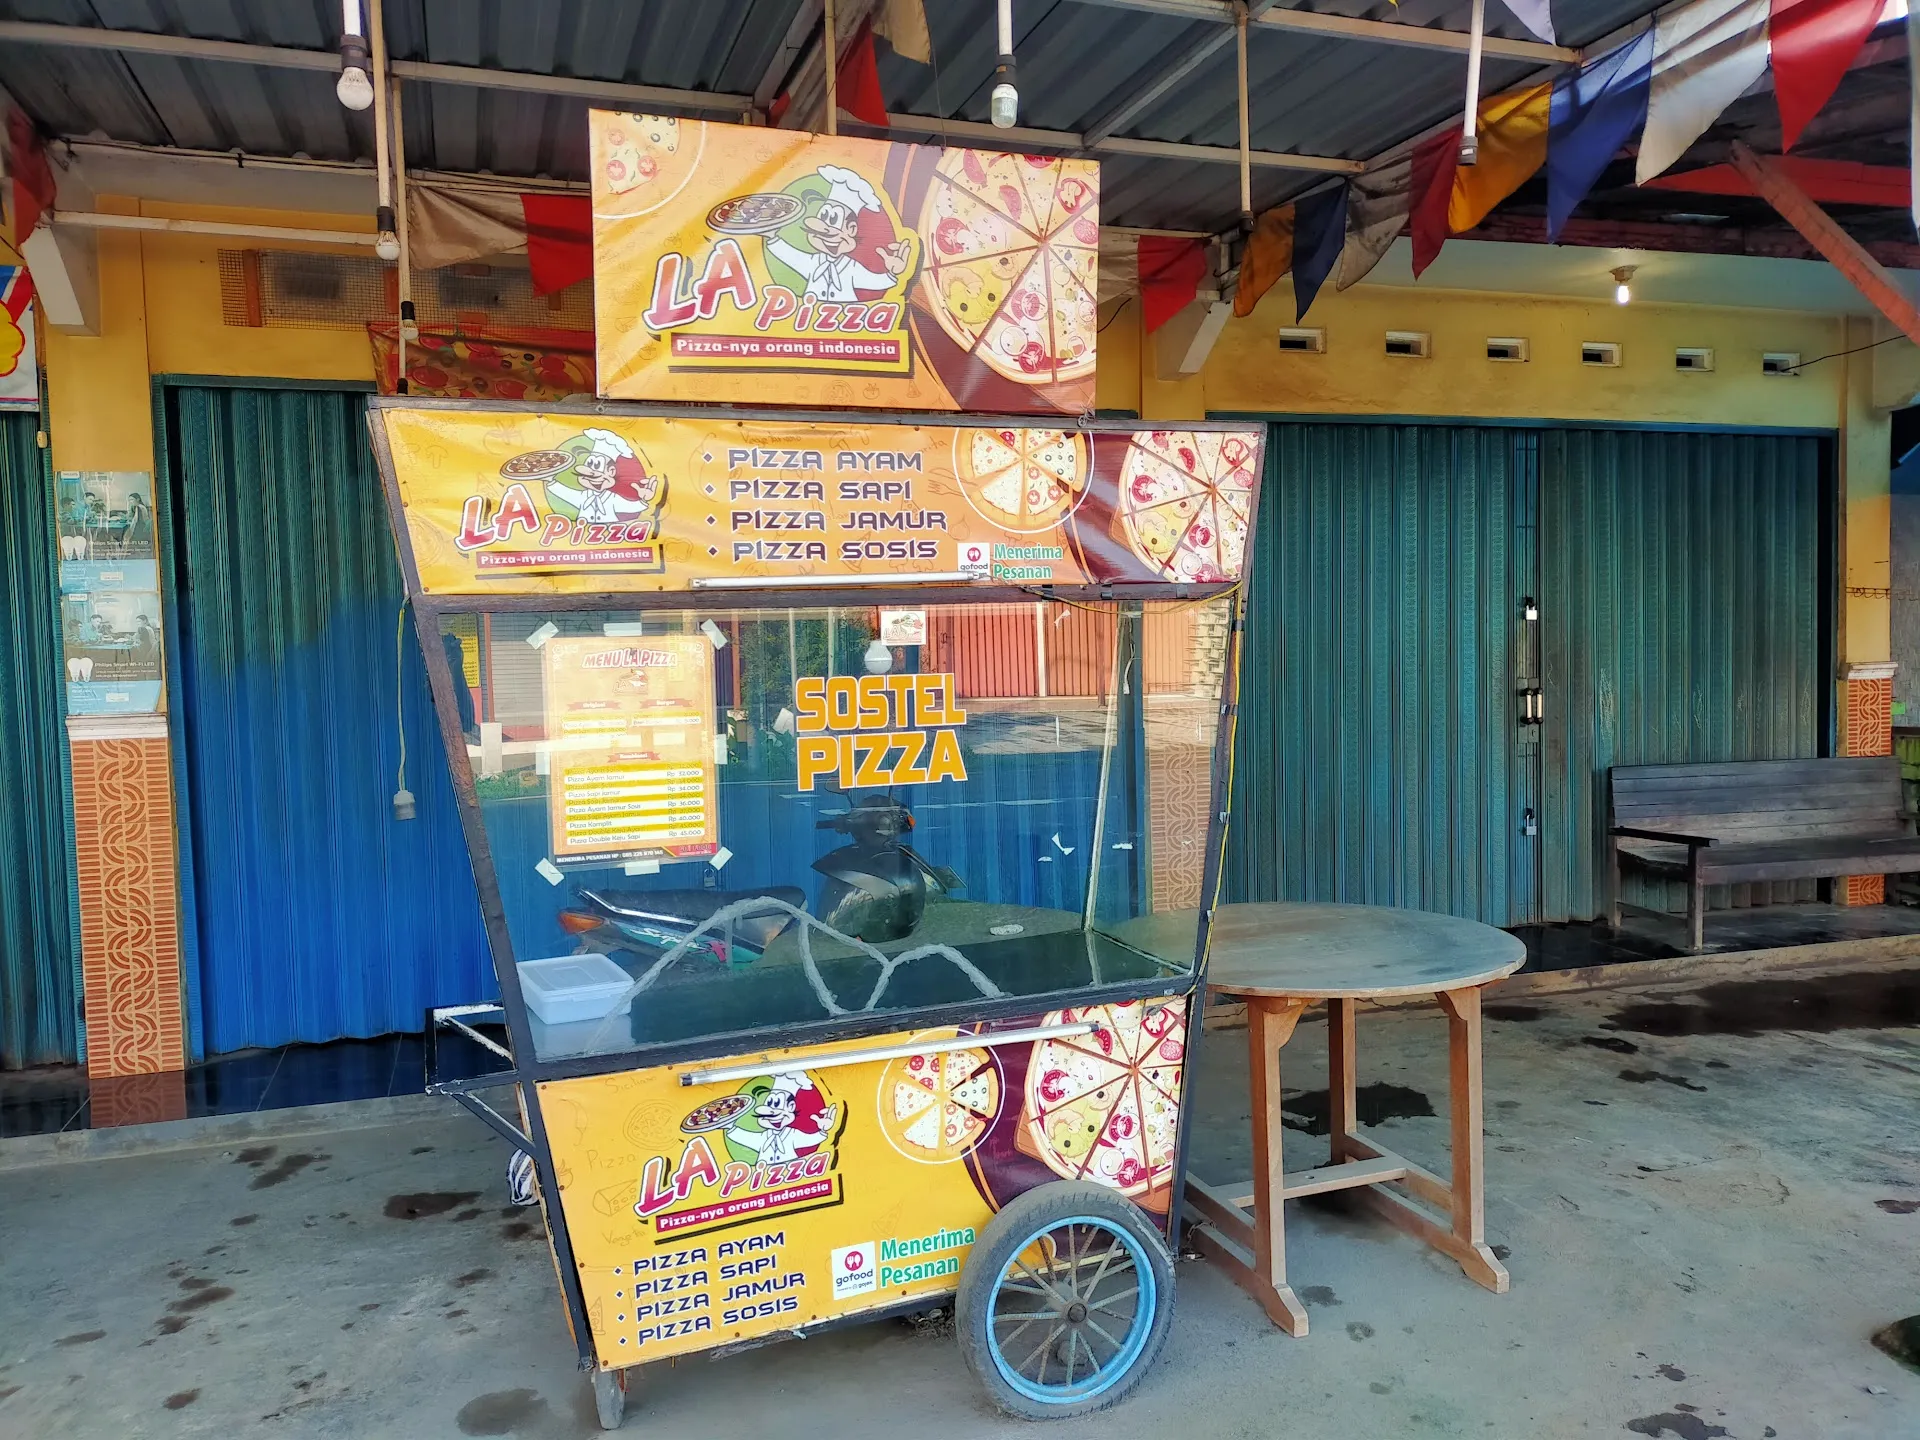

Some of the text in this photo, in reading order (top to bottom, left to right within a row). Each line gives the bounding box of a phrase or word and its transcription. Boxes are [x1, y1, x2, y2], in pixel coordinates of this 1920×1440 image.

[642, 238, 900, 332] LA Pizza
[676, 339, 896, 356] Pizza-nya orang indonesia
[729, 447, 922, 471] PIZZA AYAM
[730, 478, 911, 501] PIZZA SAPI
[455, 484, 652, 551] LA Pizza
[732, 509, 948, 532] PIZZA JAMUR
[481, 549, 650, 566] Pizza-nya orang indonesia
[733, 540, 938, 562] PIZZA SOSIS
[994, 544, 1062, 559] Menerima
[994, 563, 1051, 579] Pesanan
[584, 648, 676, 666] MENU LA PIZZA
[796, 673, 967, 731] SOSTEL
[797, 730, 968, 792] PIZZA
[587, 1149, 636, 1169] Pizza
[633, 1136, 830, 1216] LA Pizza
[660, 1183, 829, 1229] Pizza-nya orang indonesia
[634, 1232, 785, 1277] PIZZA AYAM
[881, 1229, 975, 1261] Menerima
[635, 1254, 776, 1299] PIZZA SAPI
[835, 1268, 874, 1287] gofood
[881, 1257, 959, 1287] Pesanan
[637, 1272, 805, 1322] PIZZA JAMUR
[639, 1316, 711, 1346] PIZZA
[723, 1296, 798, 1325] SOSIS
